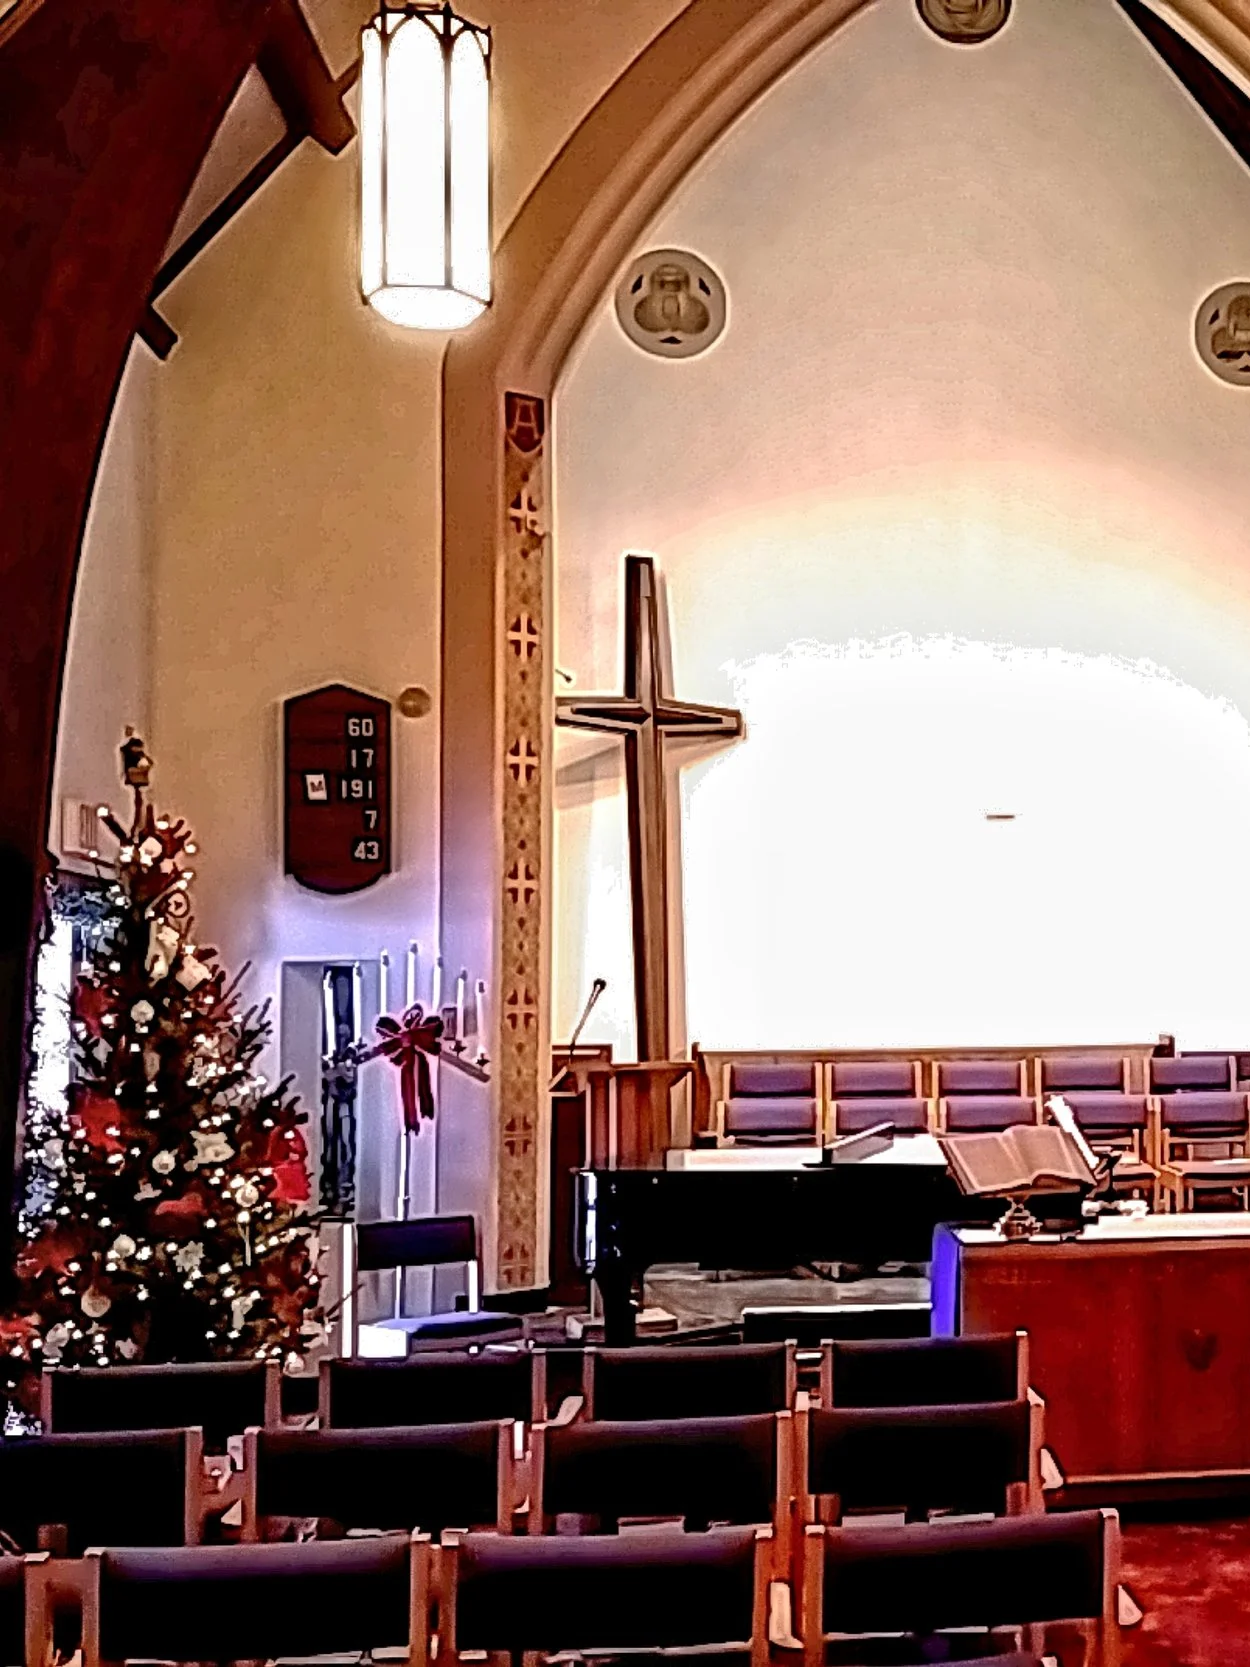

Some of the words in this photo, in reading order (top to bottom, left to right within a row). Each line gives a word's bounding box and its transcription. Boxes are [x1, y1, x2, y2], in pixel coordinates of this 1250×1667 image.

[348, 718, 374, 737] 60
[350, 749, 374, 768] 17
[310, 781, 324, 793] M
[341, 779, 373, 799] 191
[364, 810, 377, 829] 7
[354, 841, 379, 860] 43
